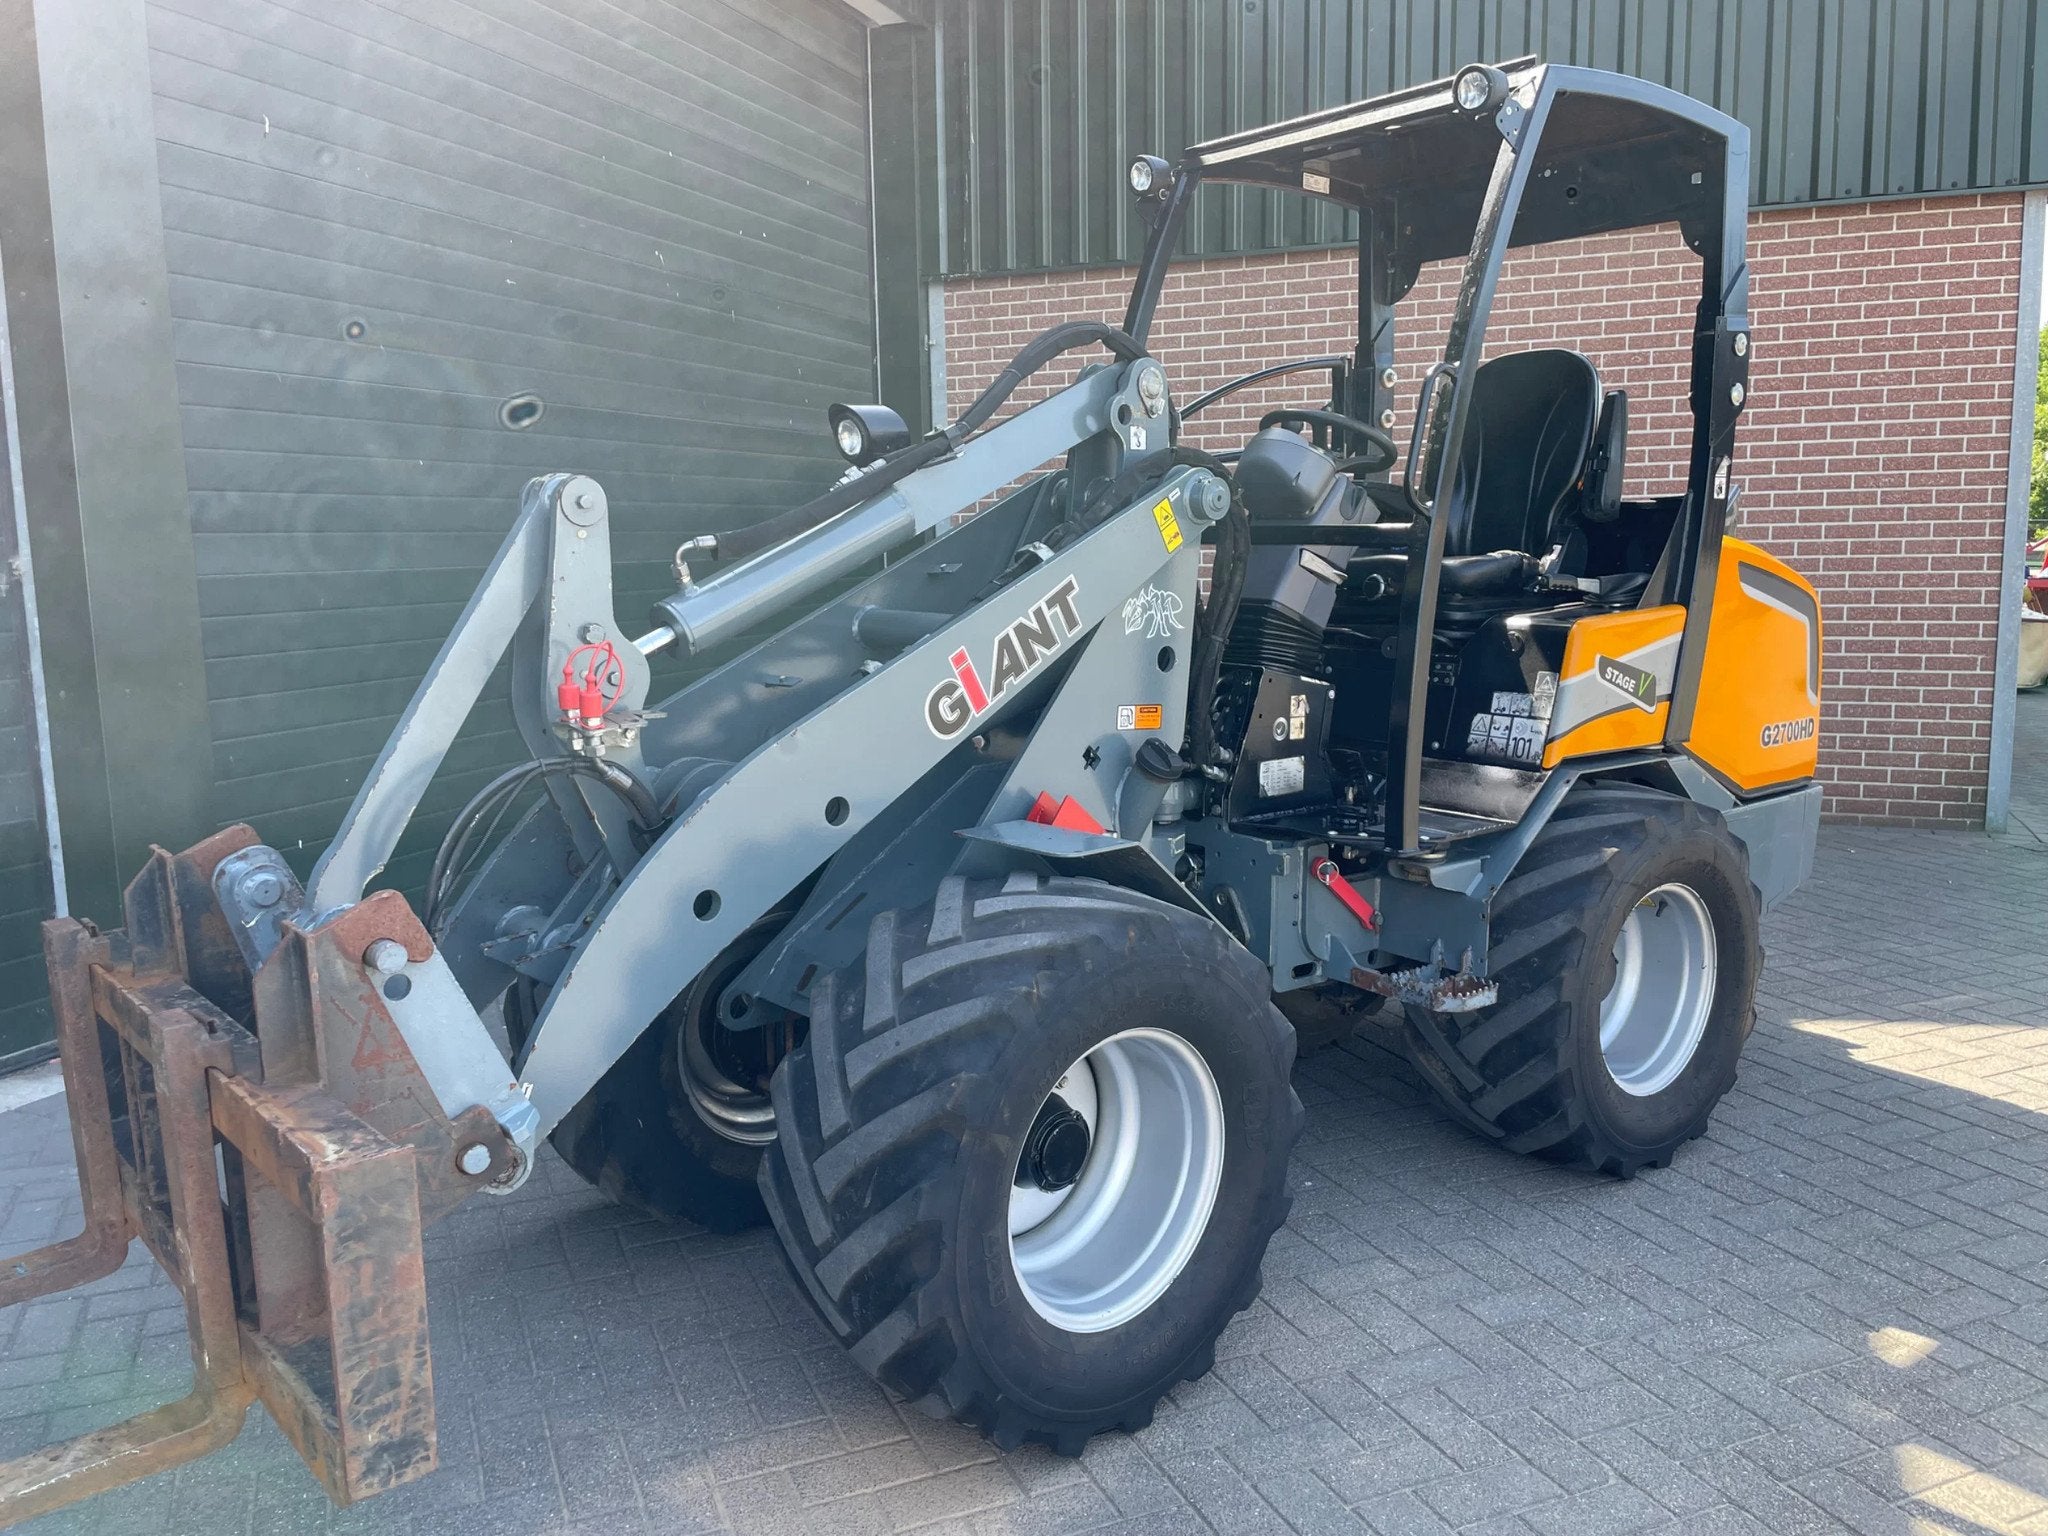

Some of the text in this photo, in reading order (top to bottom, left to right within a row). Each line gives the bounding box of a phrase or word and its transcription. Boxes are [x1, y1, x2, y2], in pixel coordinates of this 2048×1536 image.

[1604, 666, 1655, 697] STAGE V
[1512, 736, 1532, 760] 101
[1760, 717, 1815, 748] G2700HD
